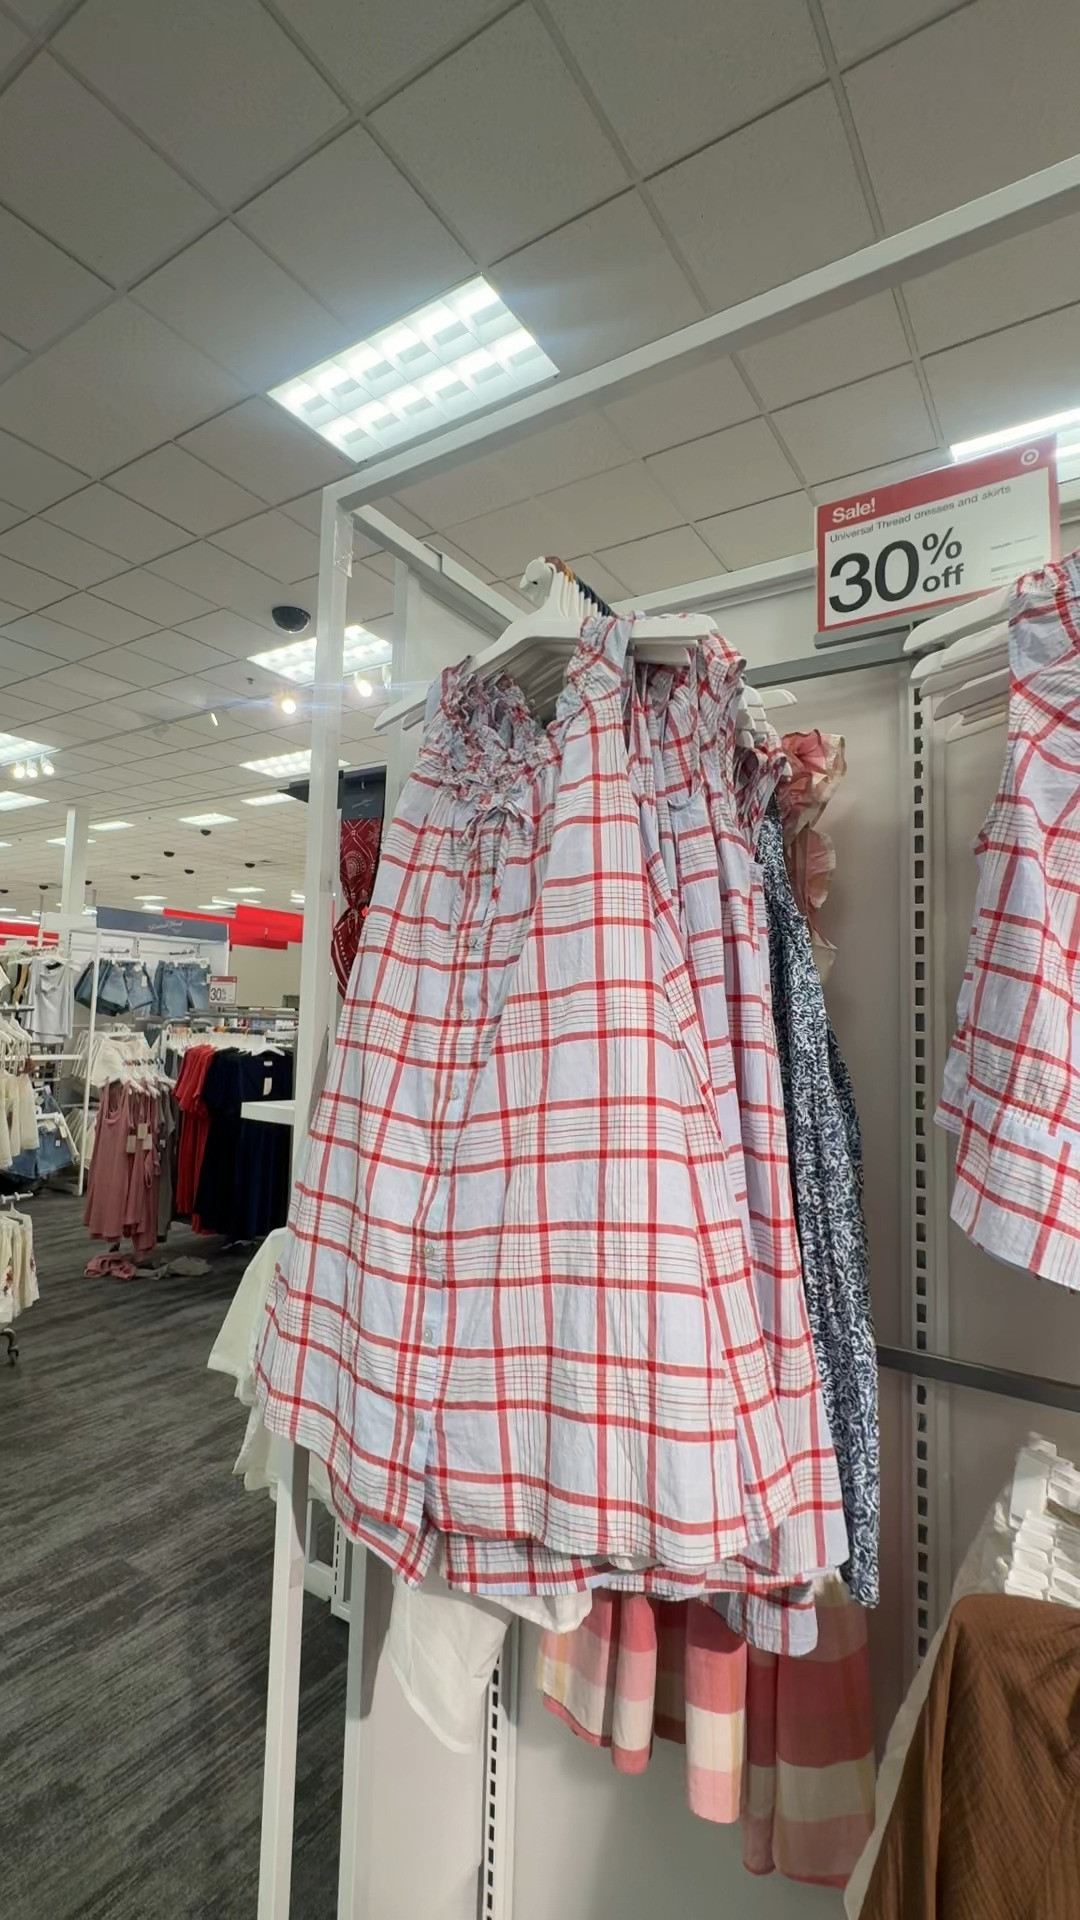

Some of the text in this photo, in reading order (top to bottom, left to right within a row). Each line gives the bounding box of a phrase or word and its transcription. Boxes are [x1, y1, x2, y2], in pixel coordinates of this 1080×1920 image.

[829, 525, 874, 543] Universal
[877, 513, 911, 530] Thread
[957, 493, 979, 508] and
[981, 484, 1012, 500] skirts
[832, 497, 876, 523] Sale!
[922, 563, 964, 593] off
